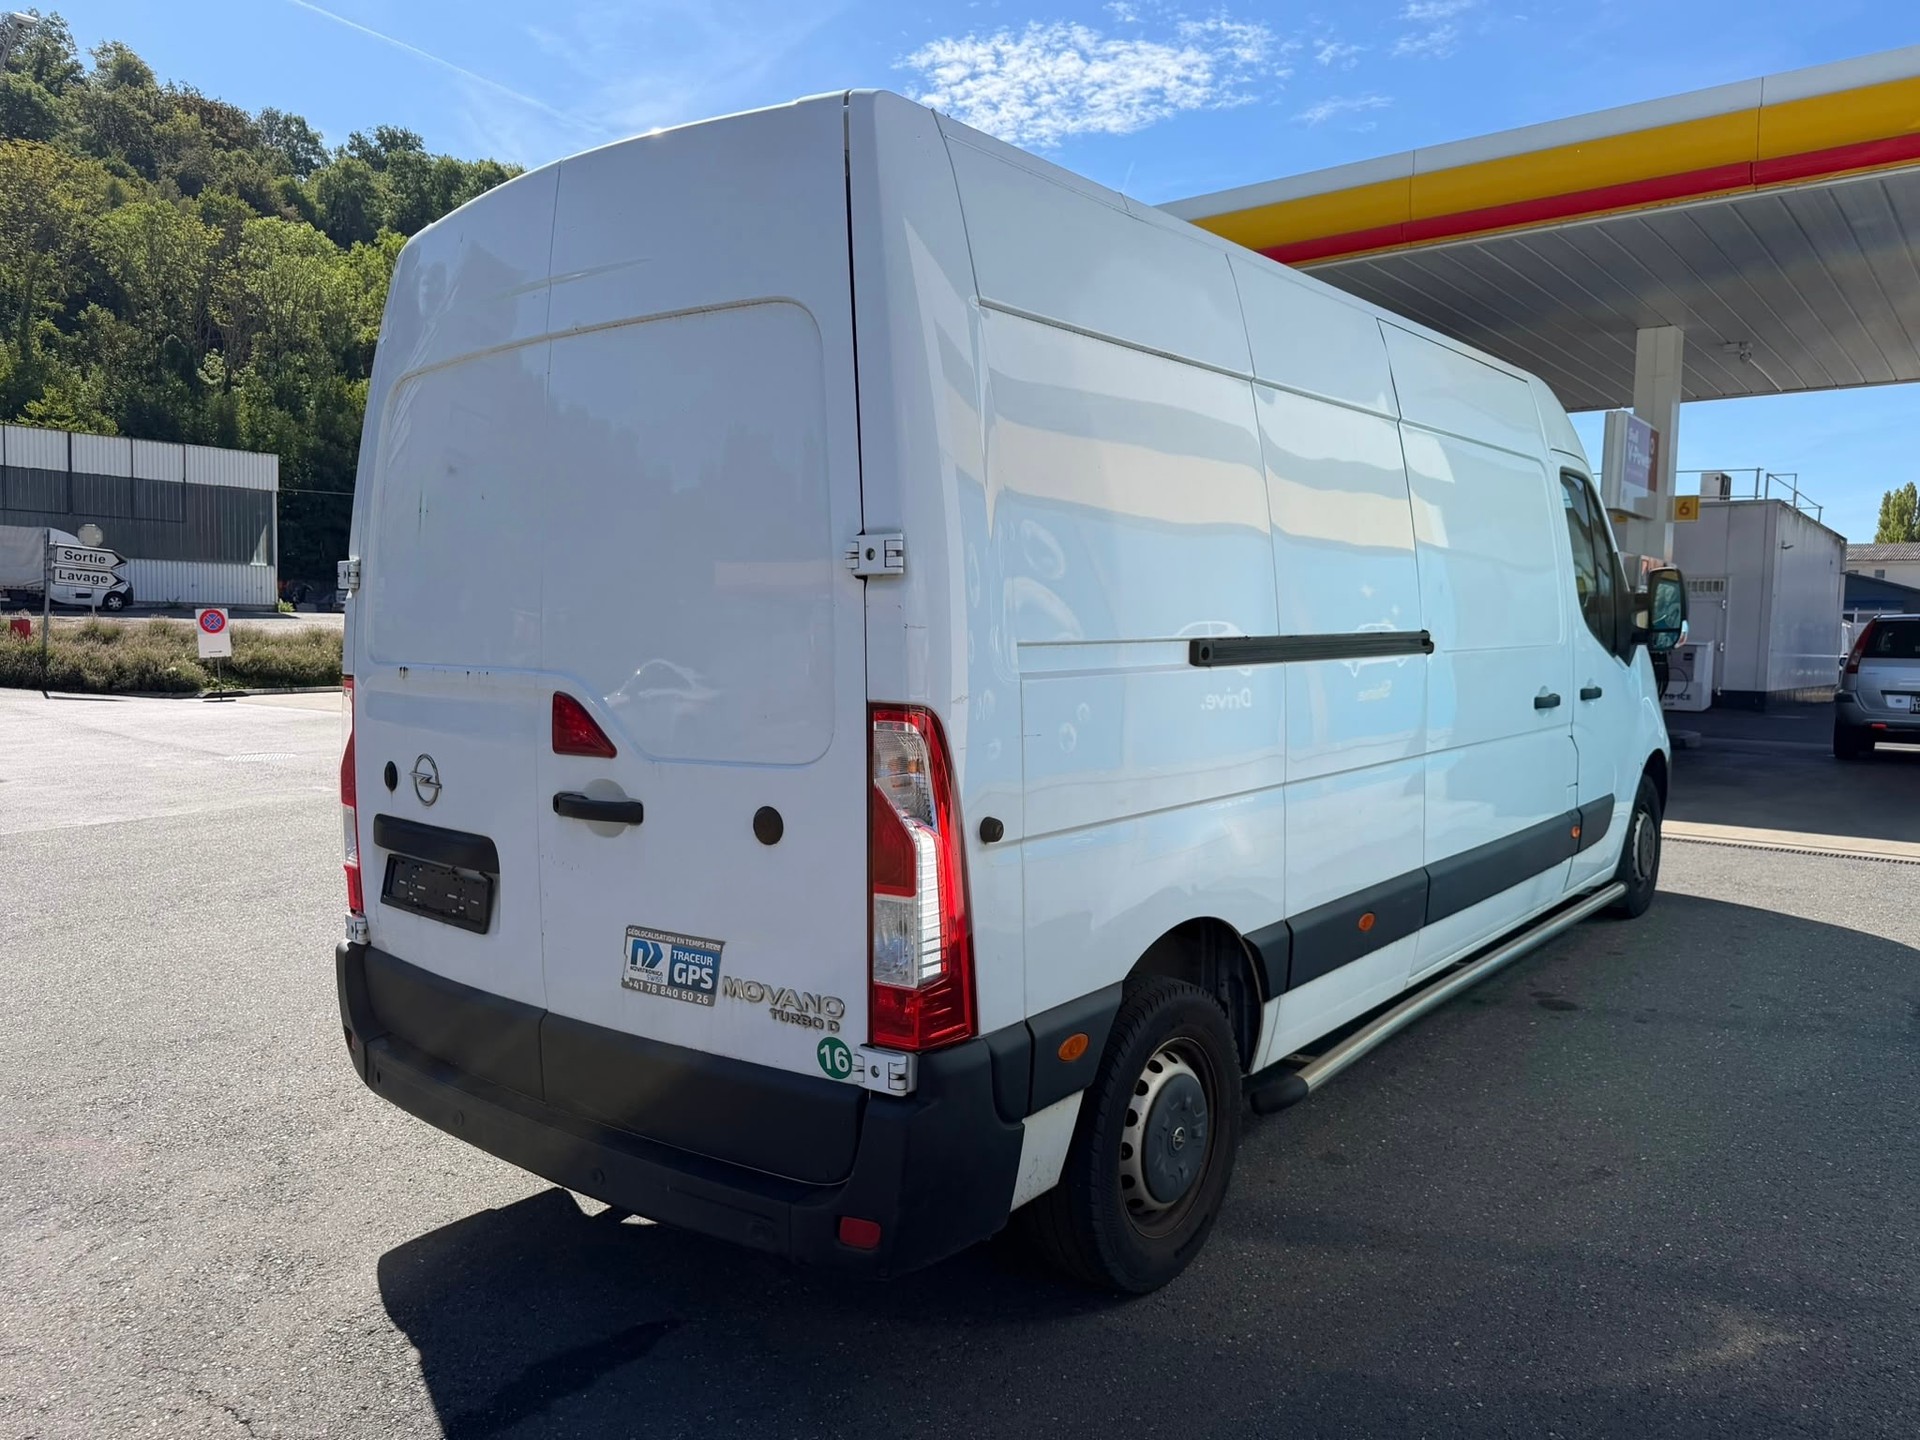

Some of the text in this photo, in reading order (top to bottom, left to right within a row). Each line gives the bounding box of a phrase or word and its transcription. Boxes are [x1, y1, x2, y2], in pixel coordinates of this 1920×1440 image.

[1678, 501, 1690, 515] 6
[64, 550, 106, 564] Sortie
[59, 569, 108, 585] Lavage
[685, 939, 705, 949] TEMPS
[672, 949, 713, 966] TRACEUR
[673, 963, 714, 989] GPS
[629, 980, 709, 1004] +41 78 840 60 26
[722, 975, 845, 1020] MOVANO
[769, 1007, 840, 1033] TURBO D
[820, 1044, 849, 1073] 16
